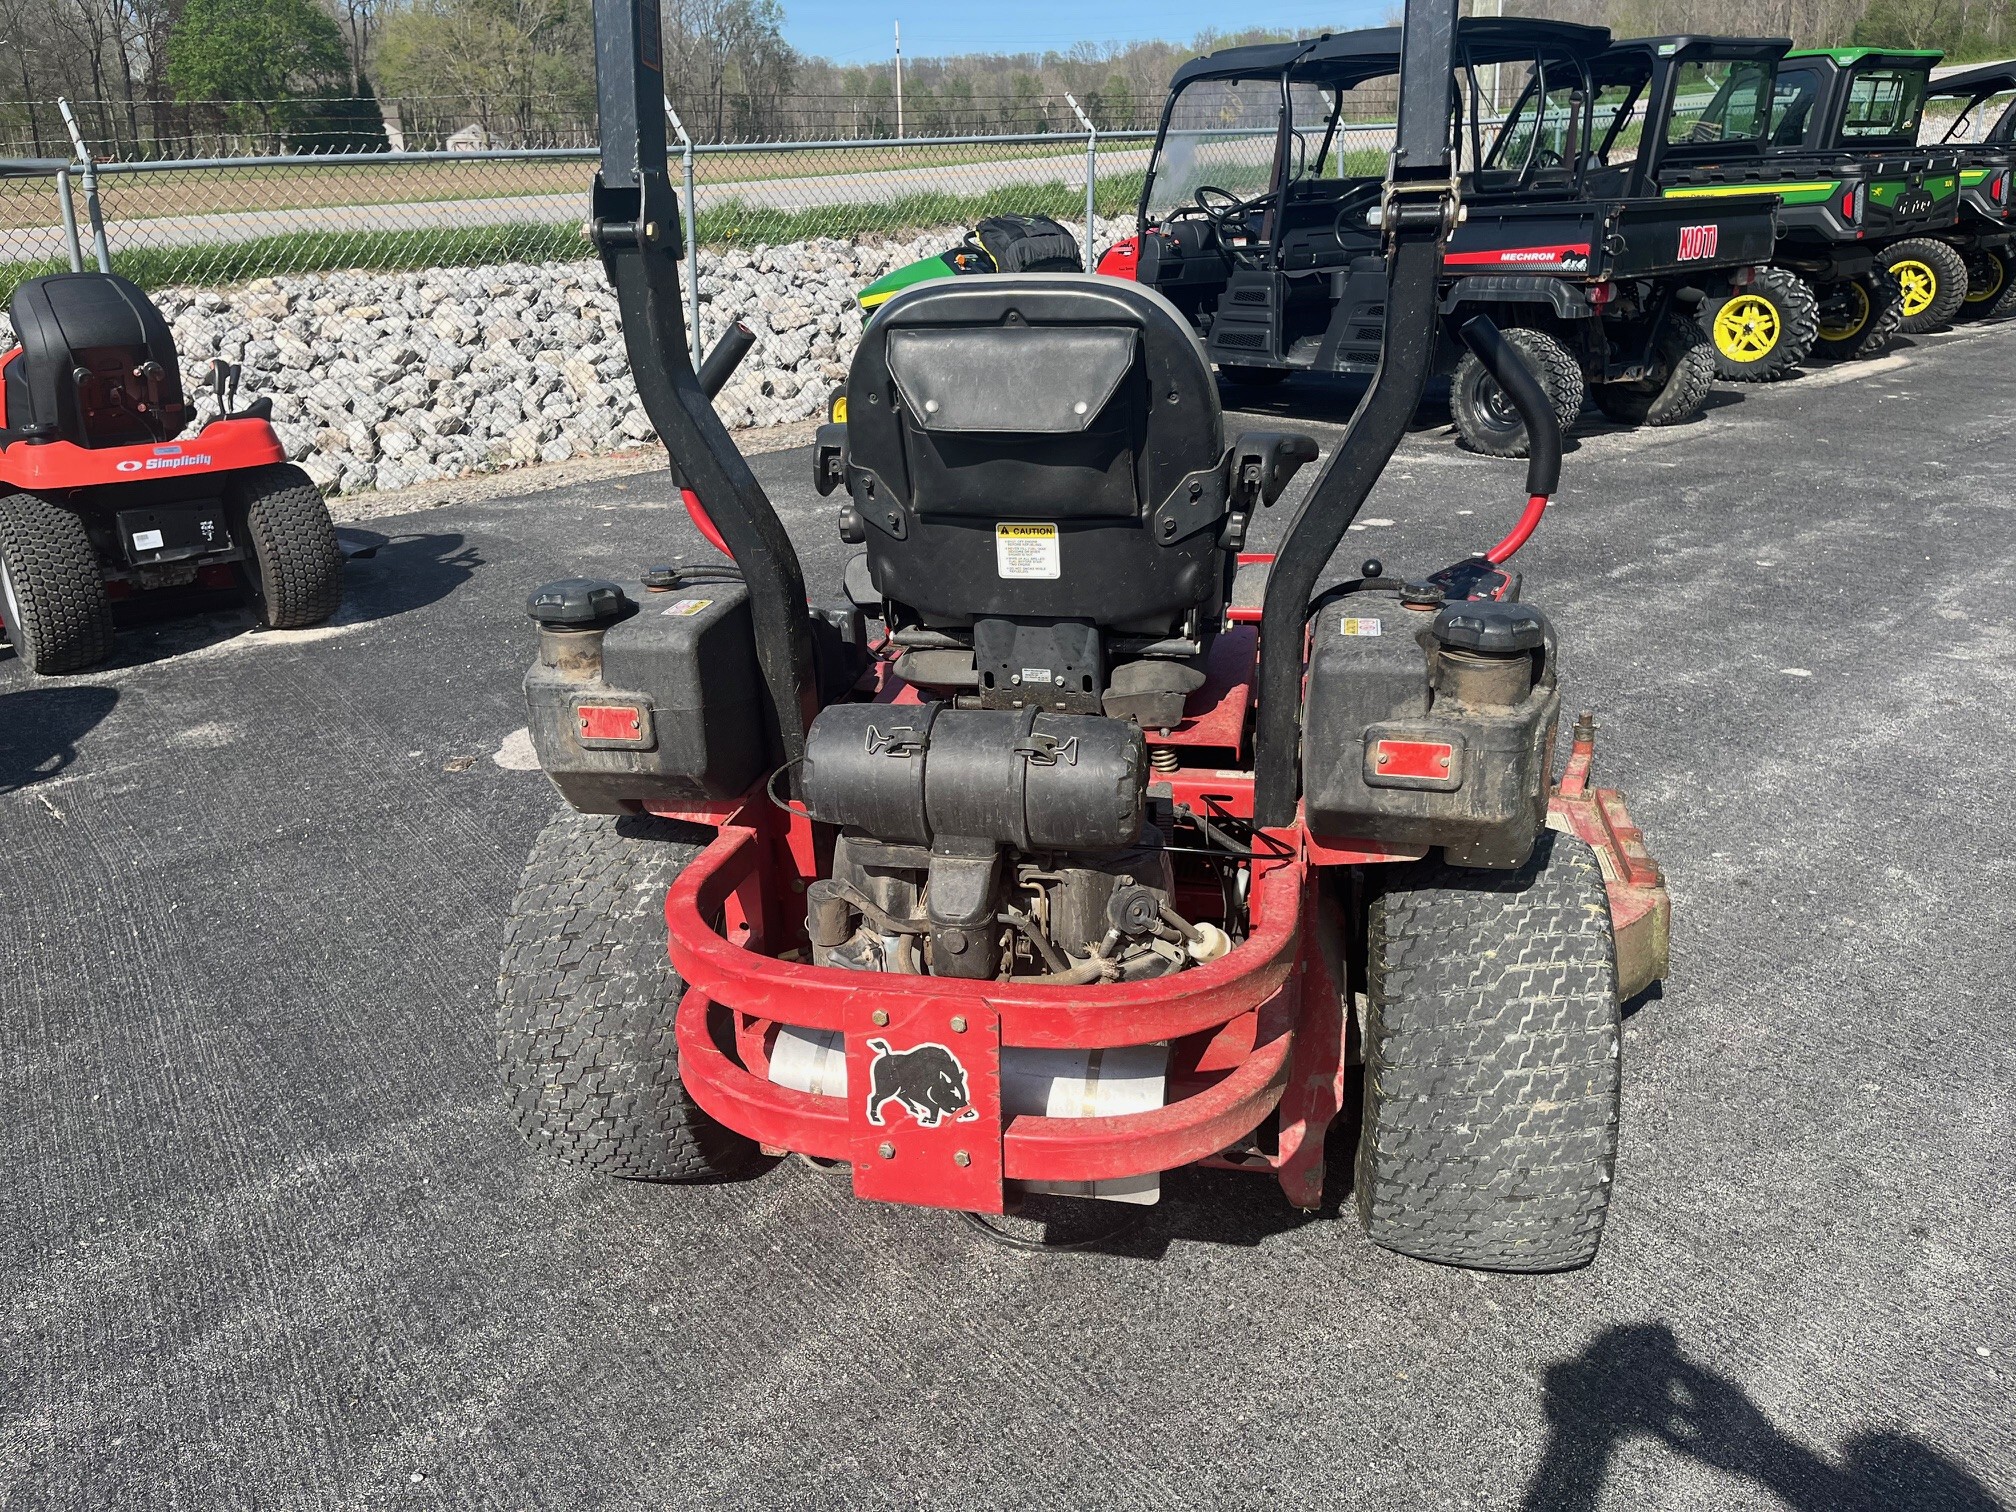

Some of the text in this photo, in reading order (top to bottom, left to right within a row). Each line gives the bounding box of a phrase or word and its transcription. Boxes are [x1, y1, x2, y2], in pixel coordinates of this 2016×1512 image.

[1677, 225, 1717, 261] KIOTI
[1500, 252, 1555, 261] MECHRON
[145, 454, 212, 470] Simplicity
[1013, 527, 1053, 535] CAUTION
